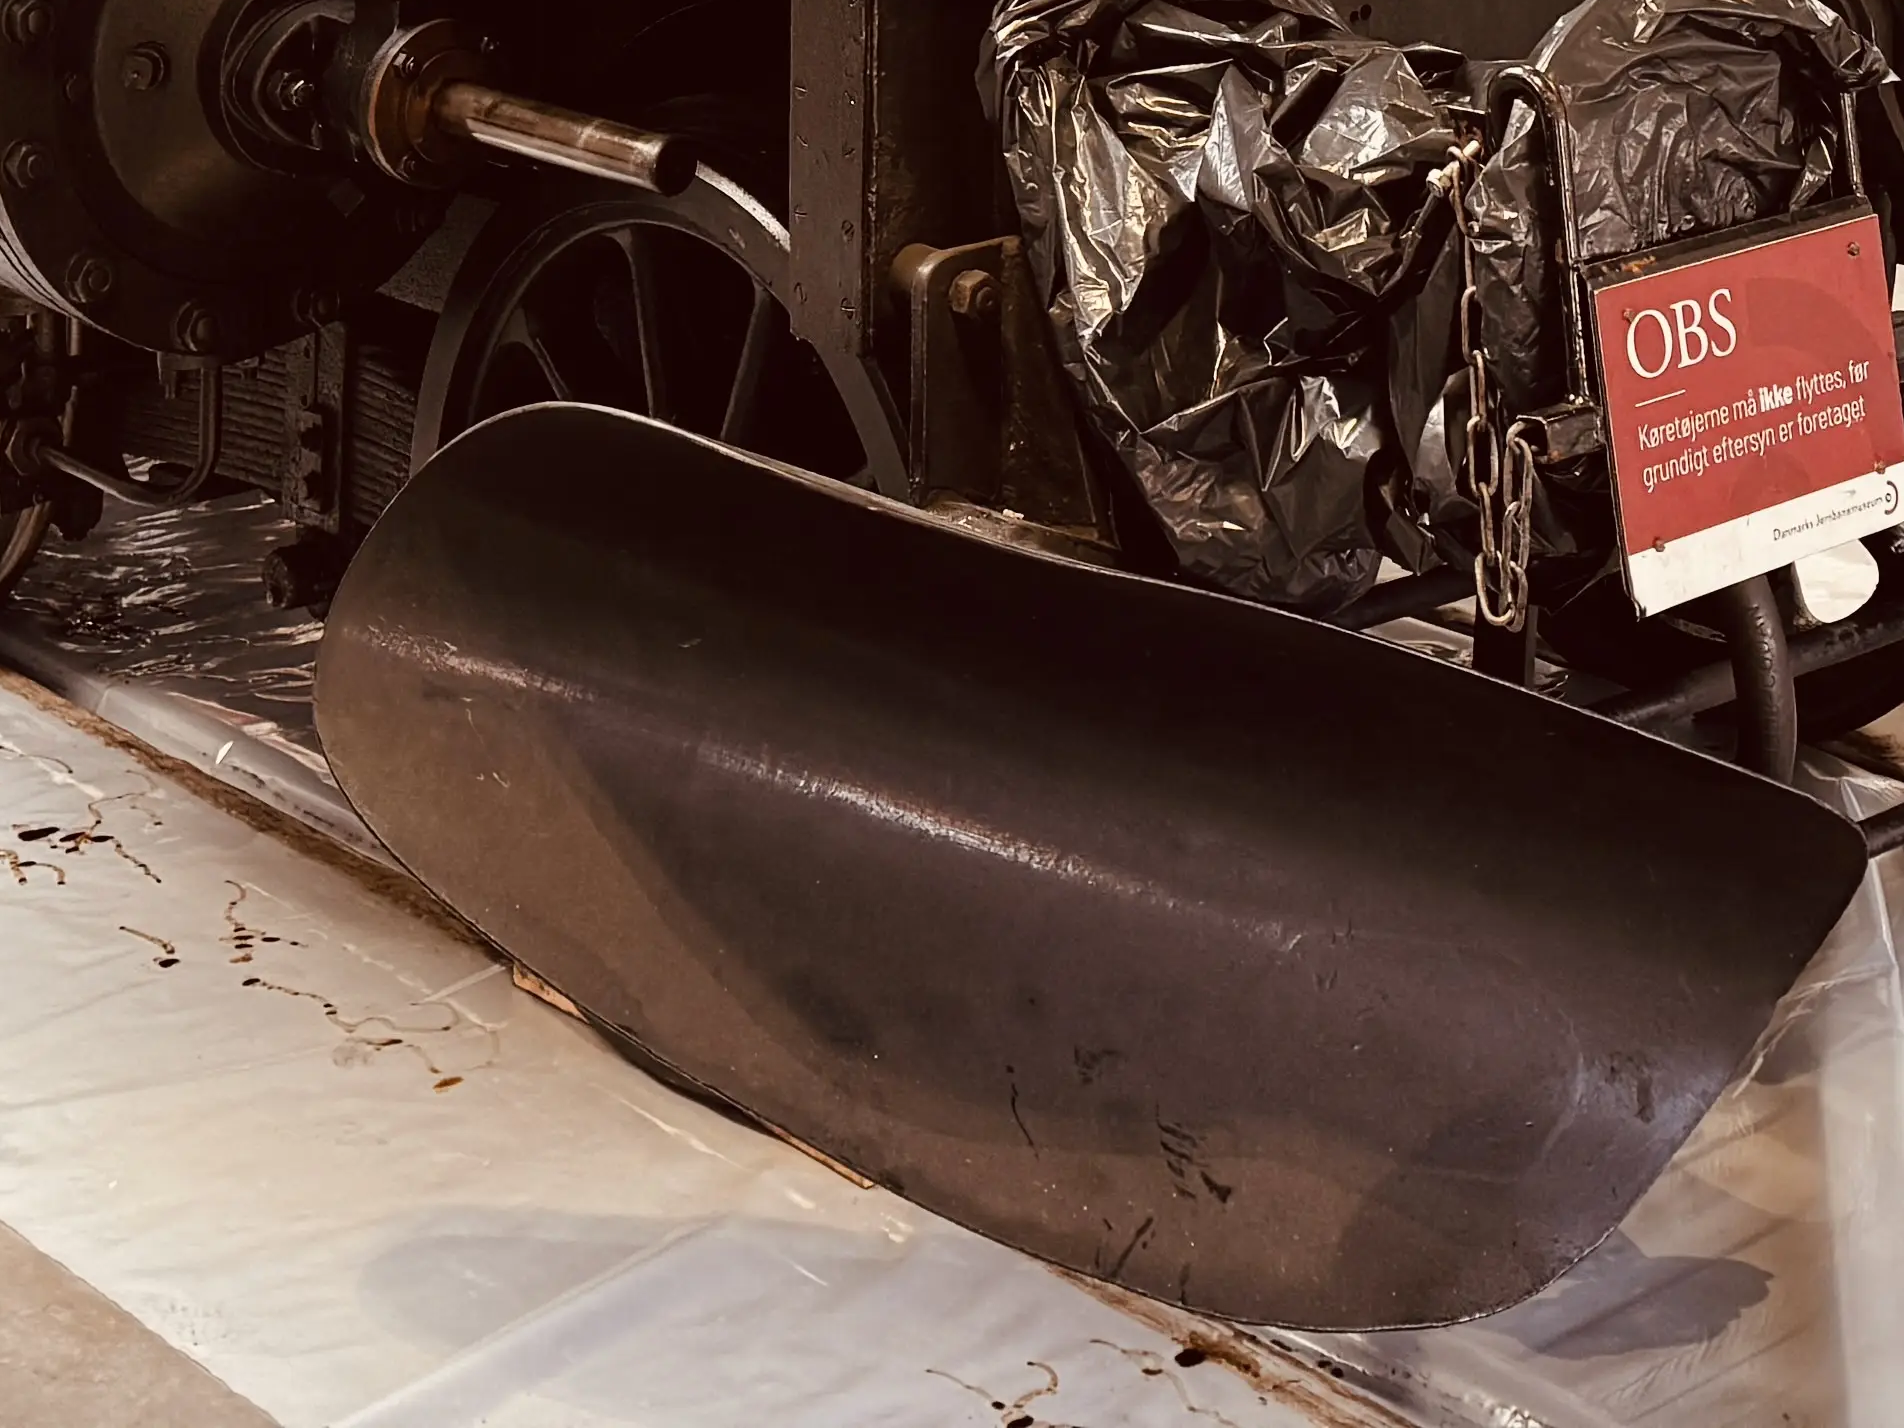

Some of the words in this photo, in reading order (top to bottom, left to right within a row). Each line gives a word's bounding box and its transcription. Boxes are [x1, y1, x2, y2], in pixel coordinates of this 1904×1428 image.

[1626, 288, 1737, 378] OBS
[1637, 408, 1730, 451] Køretøjerne
[1732, 389, 1757, 421] må
[1759, 384, 1794, 413] ikke
[1795, 369, 1846, 405] flyttes,
[1848, 359, 1870, 384] før
[1642, 445, 1710, 493] grundigt
[1712, 426, 1776, 464] eftersyn
[1778, 420, 1794, 442] er
[1796, 395, 1867, 437] foretaget
